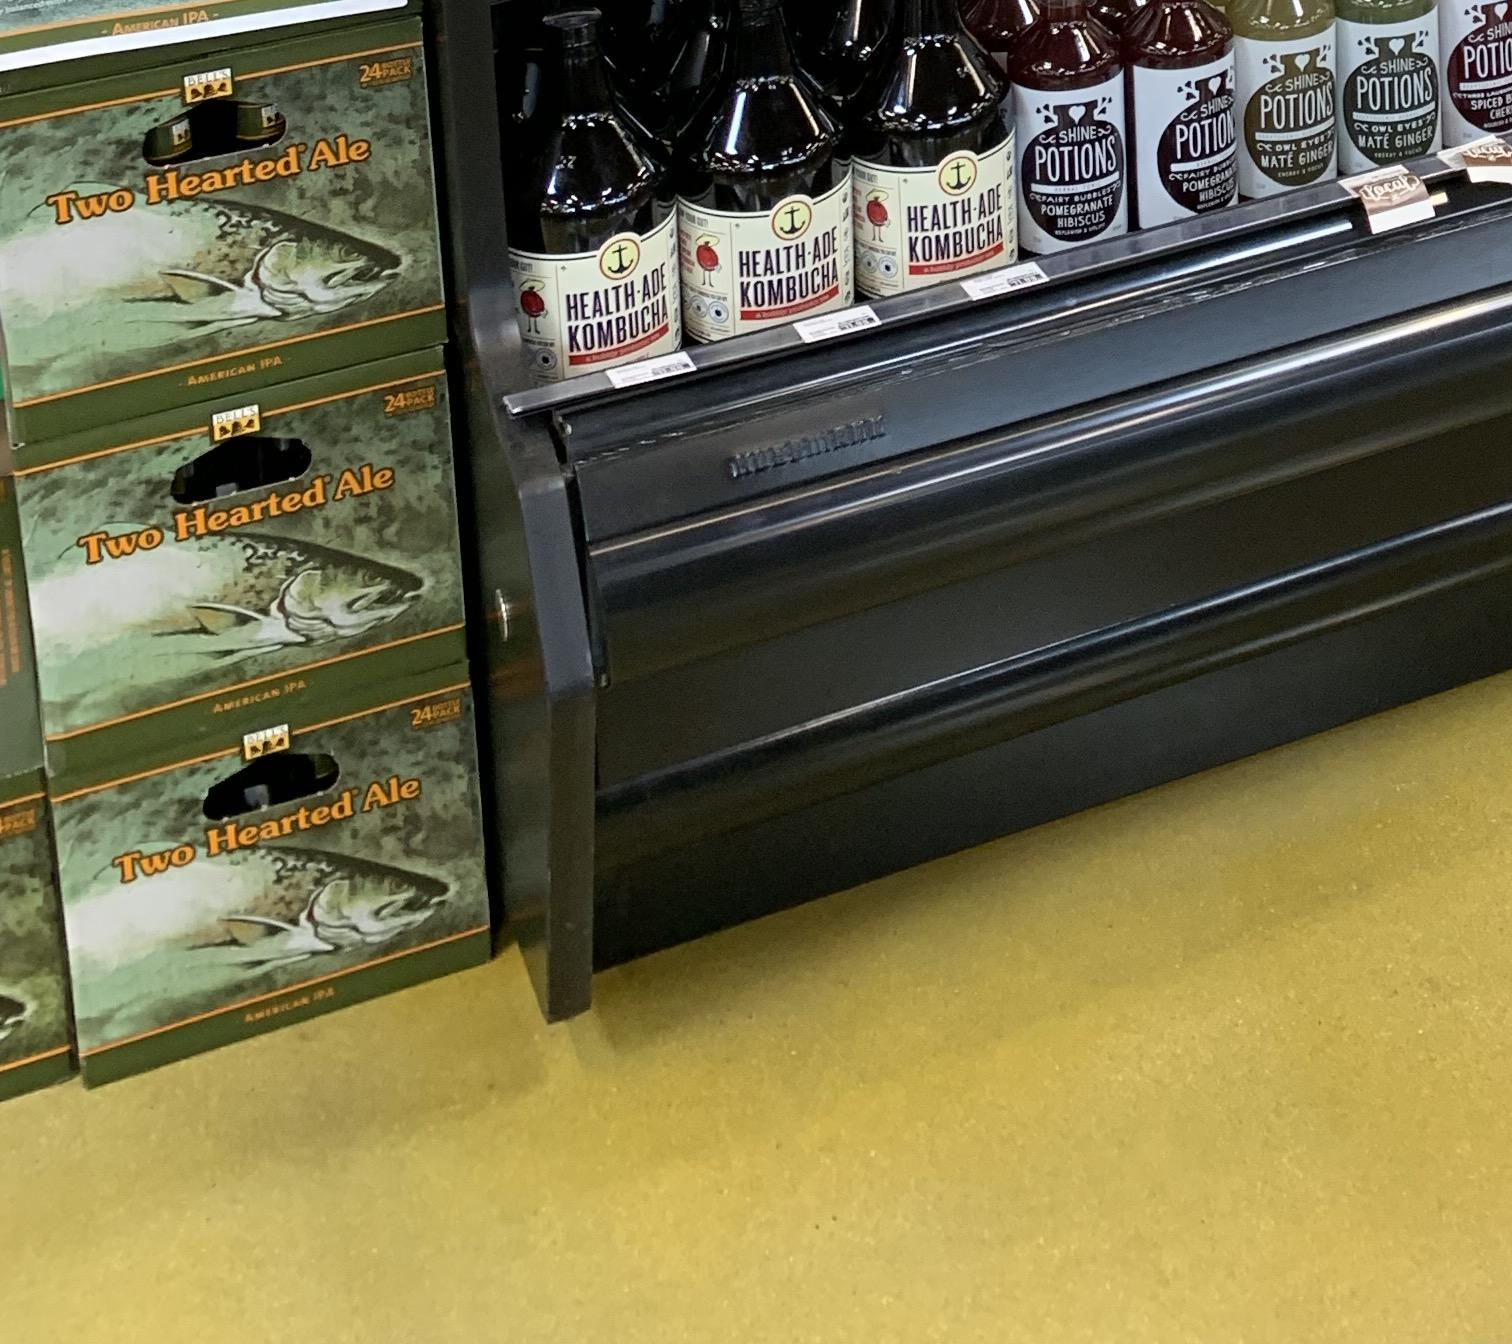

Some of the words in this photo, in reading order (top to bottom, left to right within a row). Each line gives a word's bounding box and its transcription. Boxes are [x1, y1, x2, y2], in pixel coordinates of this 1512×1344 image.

[112, 15, 180, 36] AMERICAN
[182, 10, 209, 26] IPA
[359, 63, 382, 81] 24
[382, 63, 411, 76] PACK
[1380, 57, 1416, 73] SHINE
[1284, 71, 1320, 89] SHINE
[1356, 68, 1433, 112] POTIONS
[1259, 85, 1333, 130] POTIONS
[1059, 126, 1097, 143] SHINE
[1394, 125, 1434, 146] GINGER
[1035, 135, 1116, 182] POTIONS
[47, 188, 134, 224] Two
[146, 147, 302, 205] Hearted
[309, 135, 370, 171] Ale
[1041, 195, 1113, 216] POMEGRANATE
[1057, 211, 1105, 227] HIBISCUS
[909, 221, 1003, 263] KOMBUCHA
[740, 266, 839, 308] KOMBUCHA
[568, 301, 668, 351] KOMBUCHA
[187, 361, 256, 387] AMERICAN
[78, 526, 161, 566] Two
[175, 477, 327, 541] Hearted
[333, 464, 395, 500] Ale
[112, 844, 194, 885] Two
